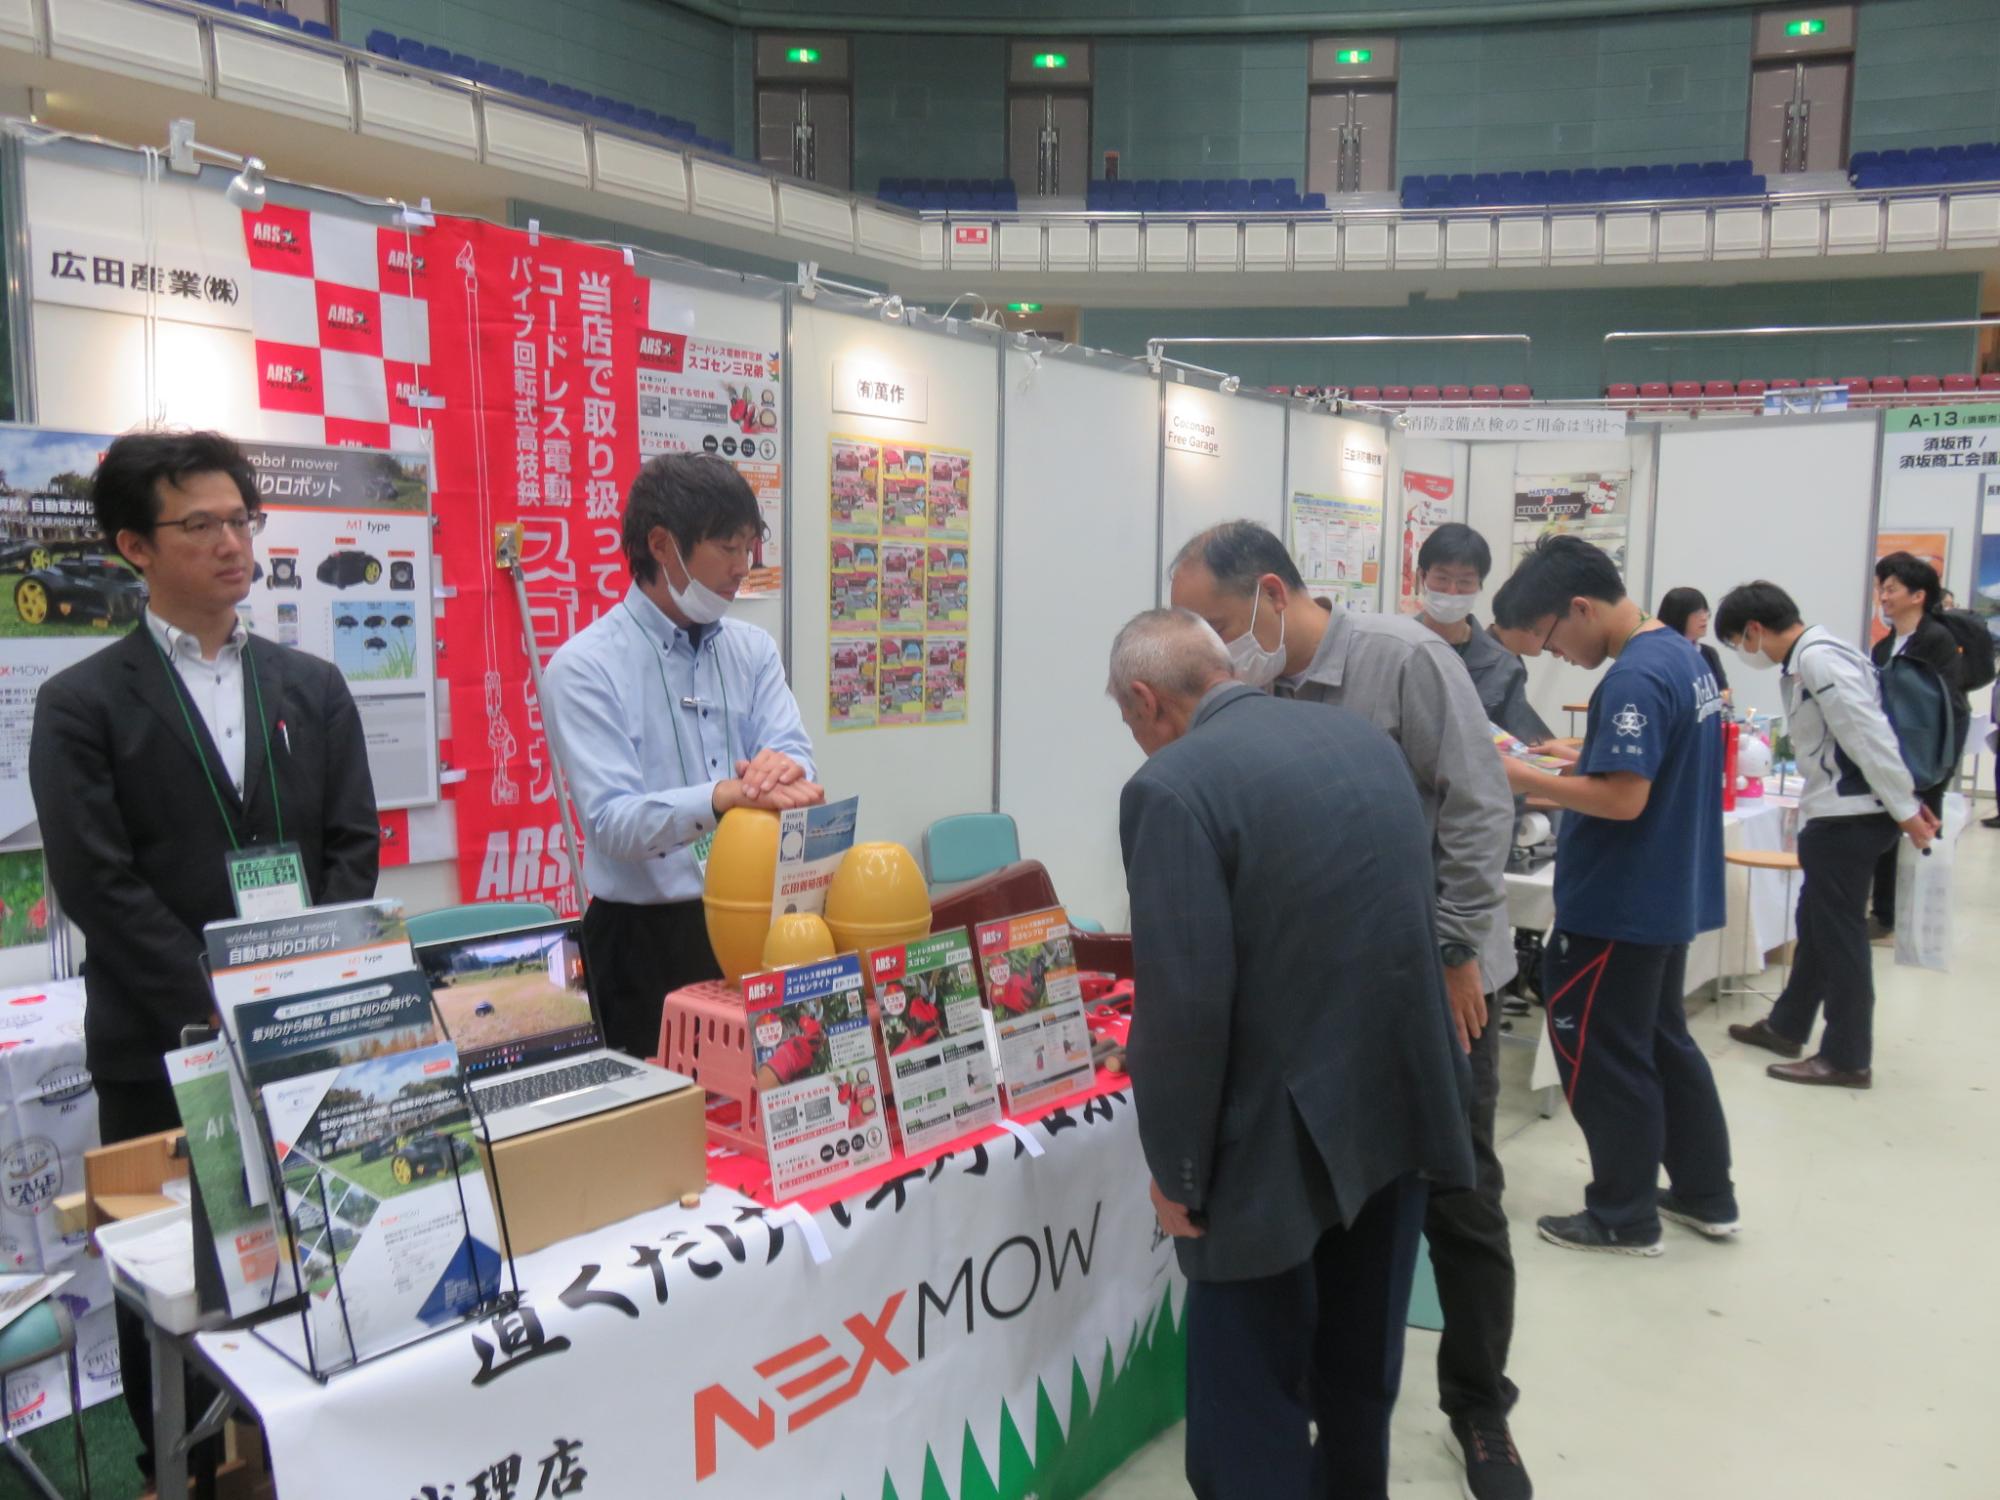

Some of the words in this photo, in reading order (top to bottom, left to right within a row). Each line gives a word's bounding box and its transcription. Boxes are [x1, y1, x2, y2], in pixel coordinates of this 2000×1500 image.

[254, 222, 281, 243] ARS
[328, 304, 354, 324] ARS
[640, 336, 664, 356] ARS
[267, 363, 292, 383] ARS
[539, 264, 572, 507] コードレス電動
[1908, 411, 1958, 428] A-13
[1168, 431, 1187, 446] Free
[1189, 436, 1219, 453] Garage
[1923, 436, 1973, 451] 須坂市
[291, 458, 339, 472] mower
[1900, 451, 2000, 469] 須坂商工会議
[367, 520, 391, 533] type
[476, 823, 577, 899] ARS
[875, 955, 891, 973] ARS
[748, 984, 767, 1001] ARS
[694, 1200, 1101, 1482] NEXMOW
